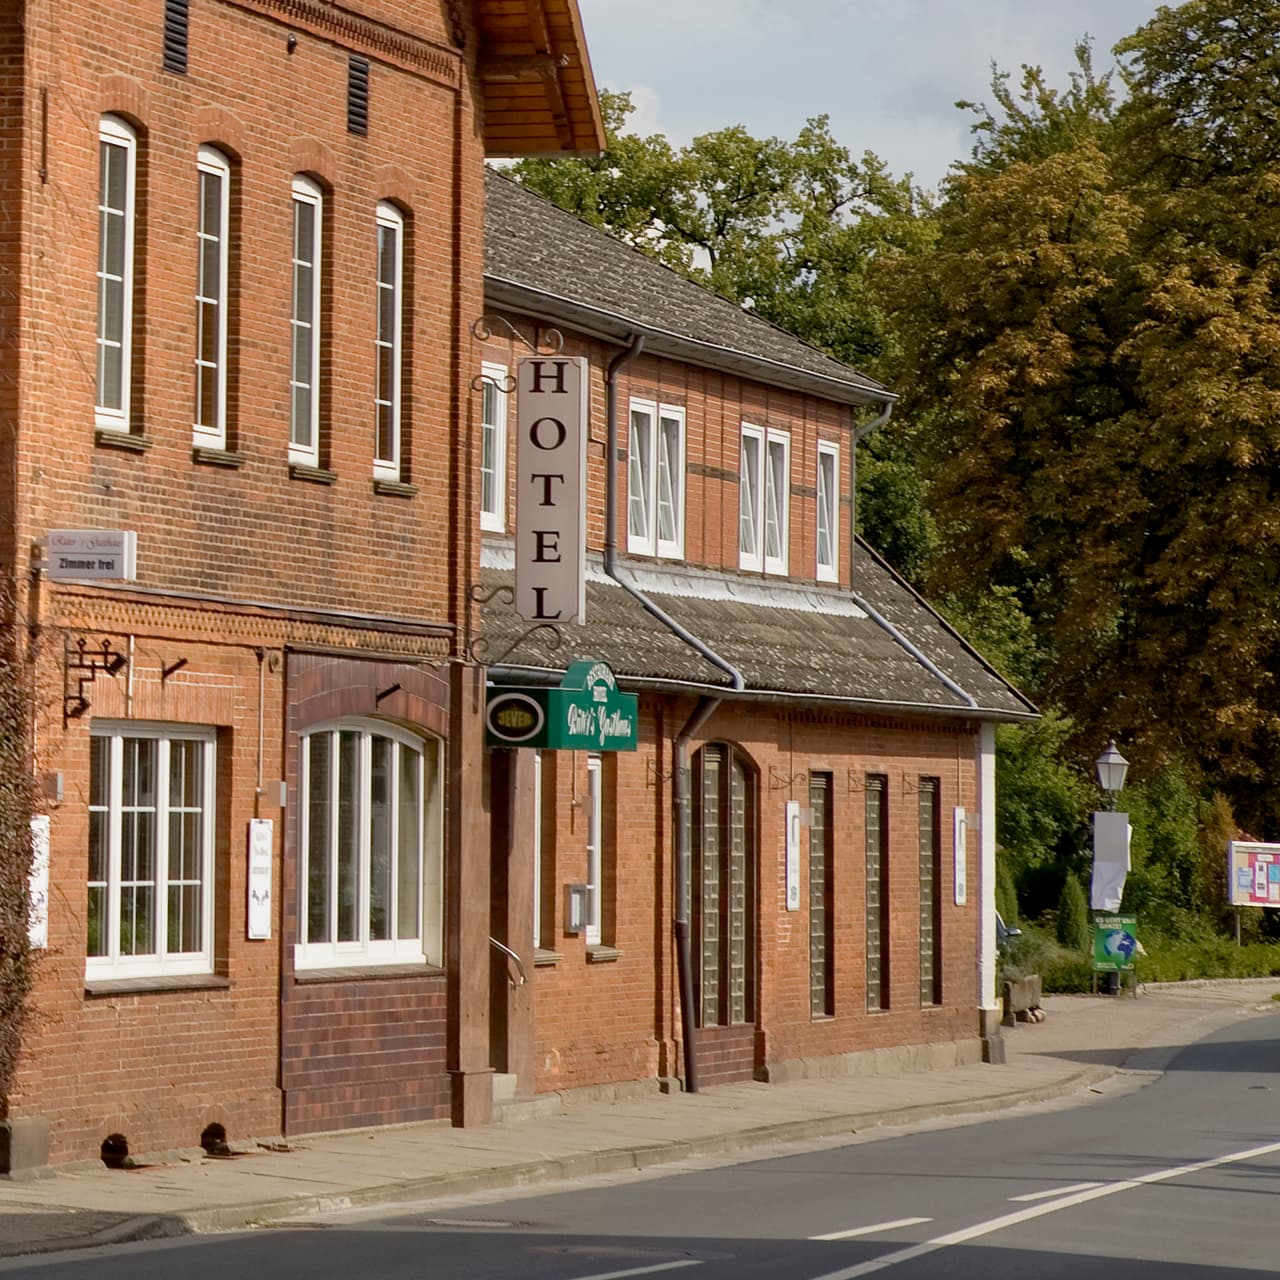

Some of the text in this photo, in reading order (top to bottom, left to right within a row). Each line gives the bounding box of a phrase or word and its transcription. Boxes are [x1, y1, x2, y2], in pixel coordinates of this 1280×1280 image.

[528, 361, 569, 620] HOTEL
[59, 558, 115, 570] Zimmer frei
